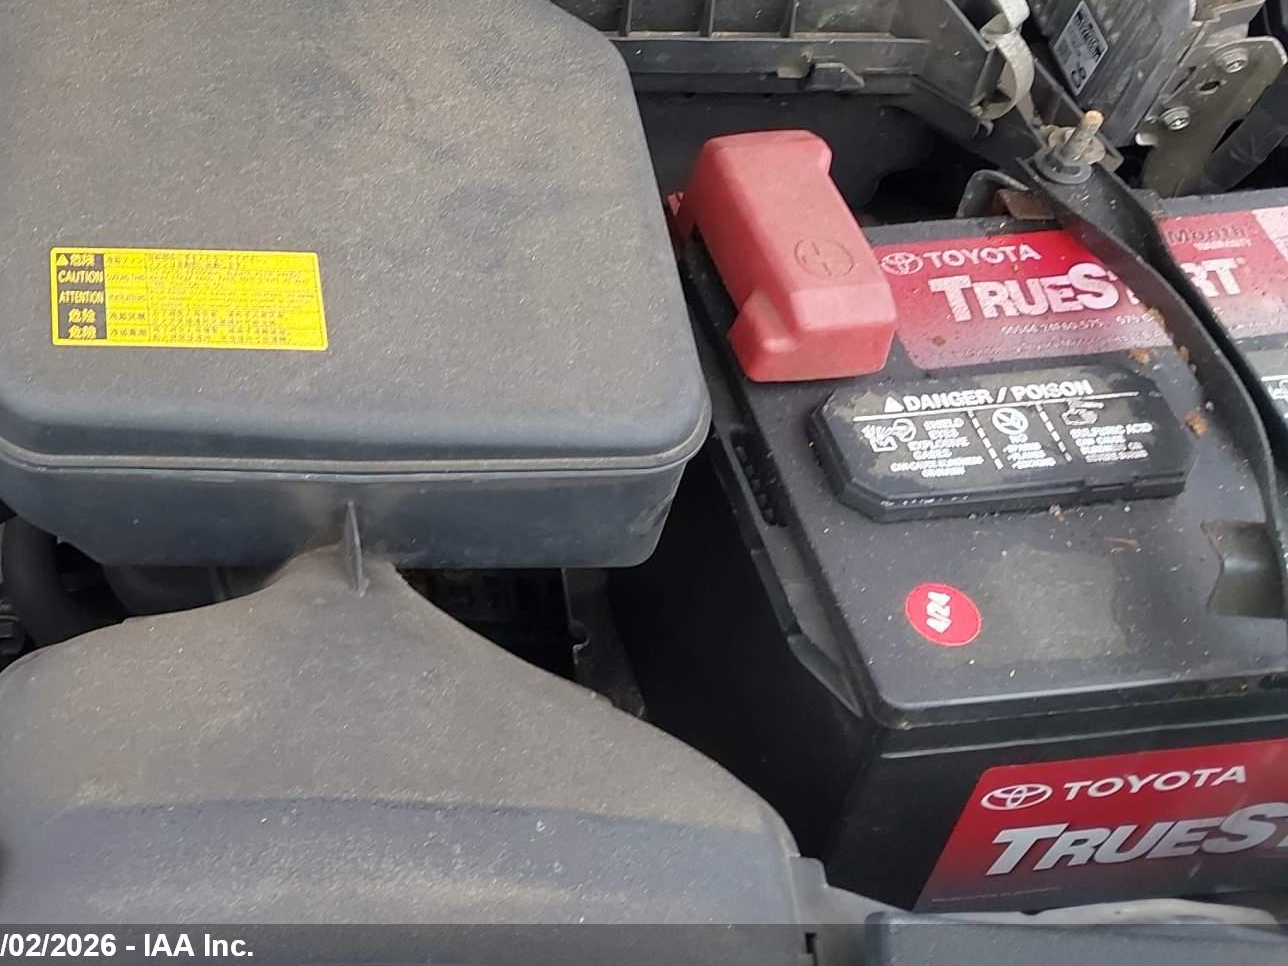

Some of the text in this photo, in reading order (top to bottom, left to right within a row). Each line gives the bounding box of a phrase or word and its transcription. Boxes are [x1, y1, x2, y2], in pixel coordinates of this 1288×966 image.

[923, 243, 1042, 269] TOYOTA
[58, 269, 104, 283] CAUTION
[59, 290, 104, 304] ATTENTION
[903, 388, 994, 412] DANGER
[1012, 379, 1093, 401] POISON
[1062, 764, 1248, 802] TOYOTA
